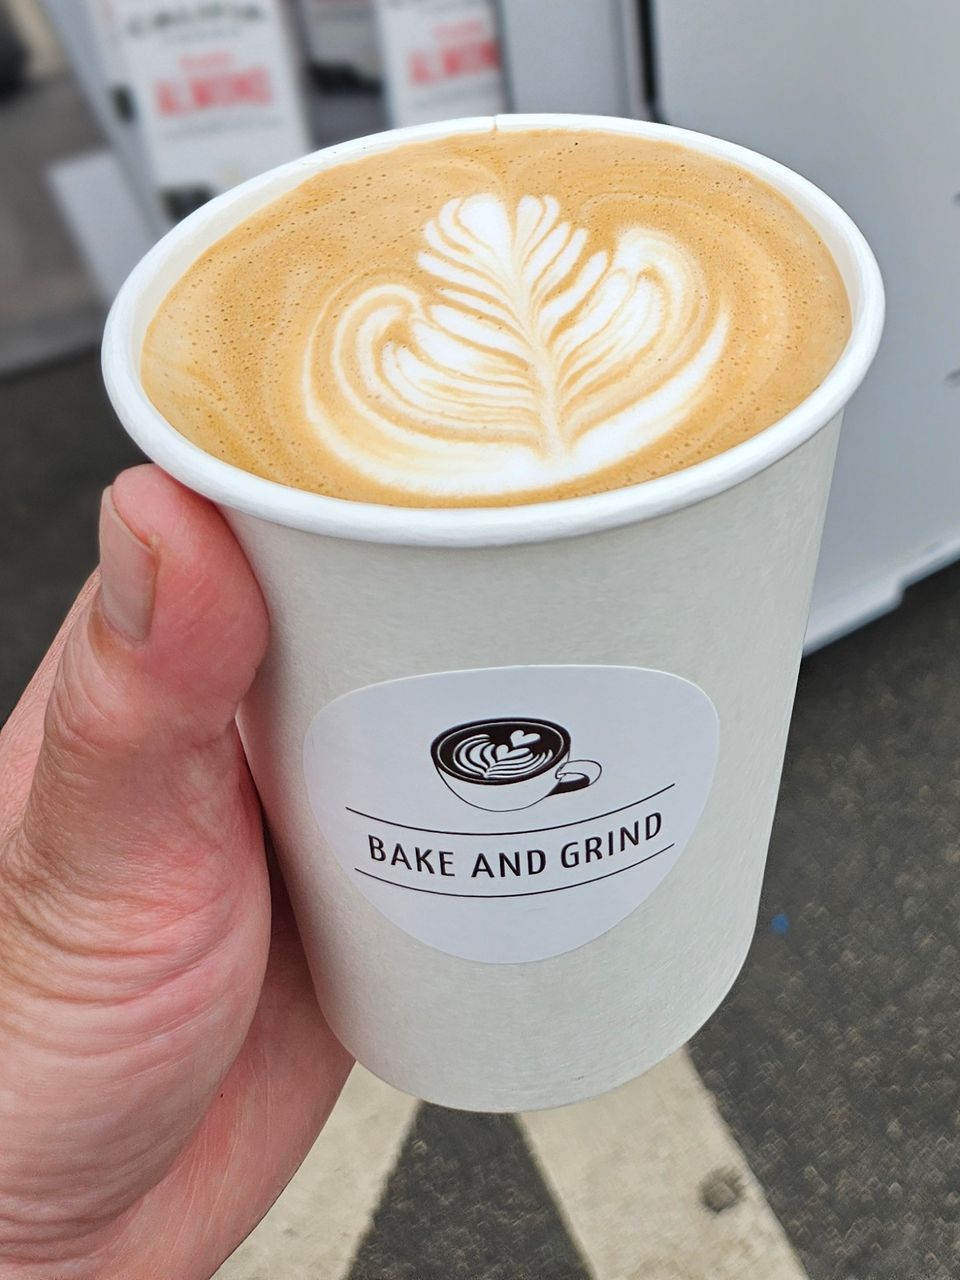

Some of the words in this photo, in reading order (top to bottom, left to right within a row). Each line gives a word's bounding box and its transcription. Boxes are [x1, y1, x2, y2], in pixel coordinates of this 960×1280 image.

[367, 833, 456, 878] BAKE
[471, 849, 547, 879] AND
[560, 811, 663, 870] GRIND
